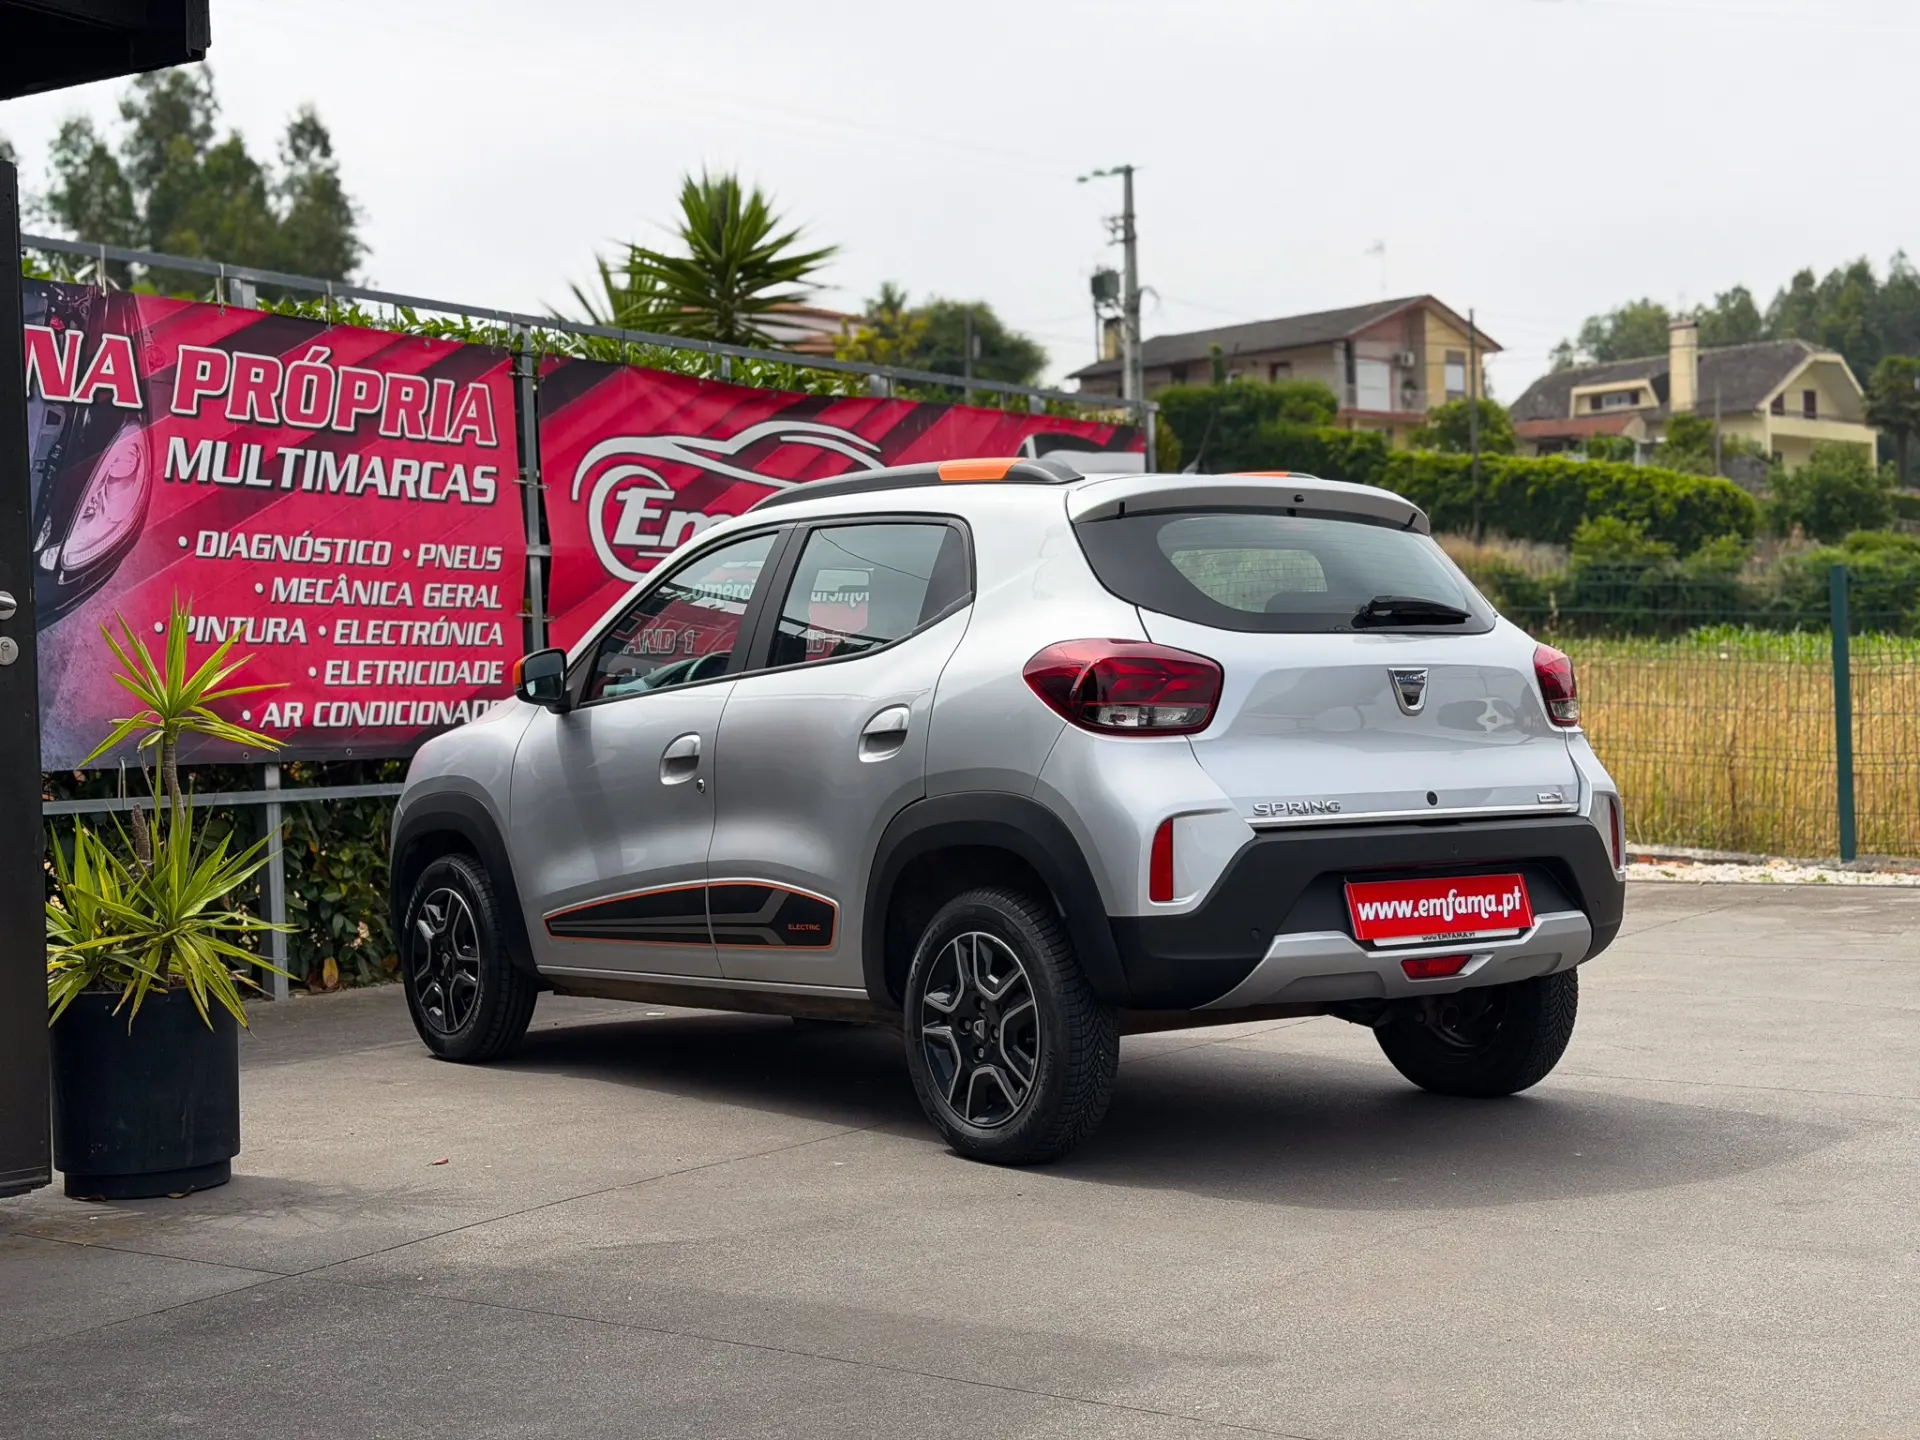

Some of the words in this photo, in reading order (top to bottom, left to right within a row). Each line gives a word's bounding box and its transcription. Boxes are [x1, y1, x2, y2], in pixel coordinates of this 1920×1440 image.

[170, 344, 498, 446] PRÓPRIA
[164, 436, 498, 504] MULTIMARCAS
[195, 529, 392, 565] DIAGNÓSTICO
[416, 544, 503, 571] PNEUS
[270, 573, 414, 607] MECÂNICA
[422, 583, 503, 609] GERAL
[333, 616, 504, 647] ELECTRÓNICA
[323, 660, 504, 686] ELETRICIDADE
[259, 701, 304, 728] AR
[313, 700, 500, 728] CONDICIONAD
[1252, 799, 1342, 816] SPRING
[1357, 885, 1522, 921] www.emfama.pt
[787, 923, 821, 931] ELECTRIC
